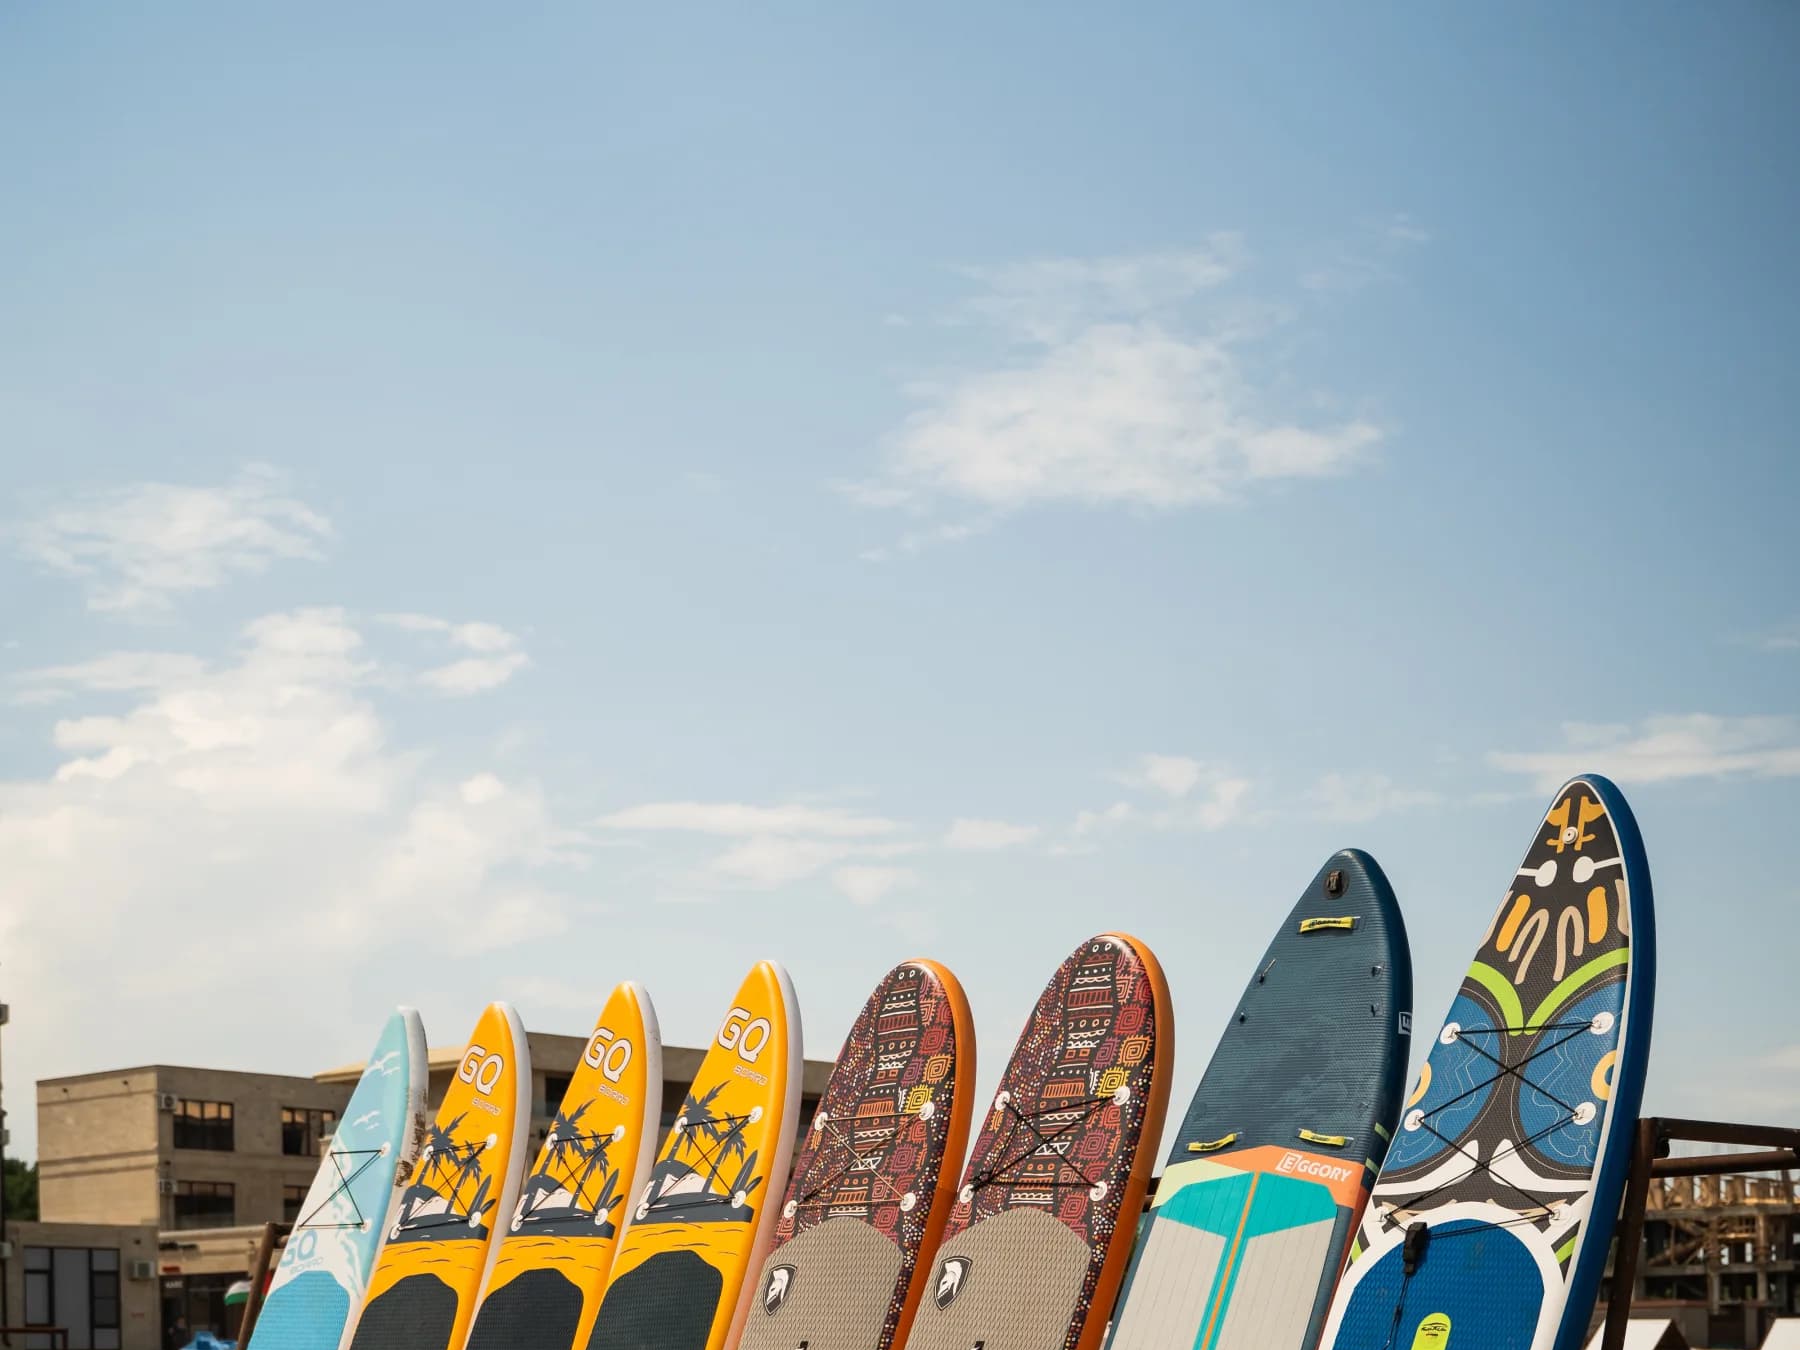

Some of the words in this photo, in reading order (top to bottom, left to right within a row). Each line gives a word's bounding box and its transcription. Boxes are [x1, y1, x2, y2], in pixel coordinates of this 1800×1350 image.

[584, 1027, 633, 1084] GQ
[718, 1006, 772, 1064] GQ
[458, 1044, 505, 1097] GQ
[1275, 1152, 1353, 1182] EGGORY
